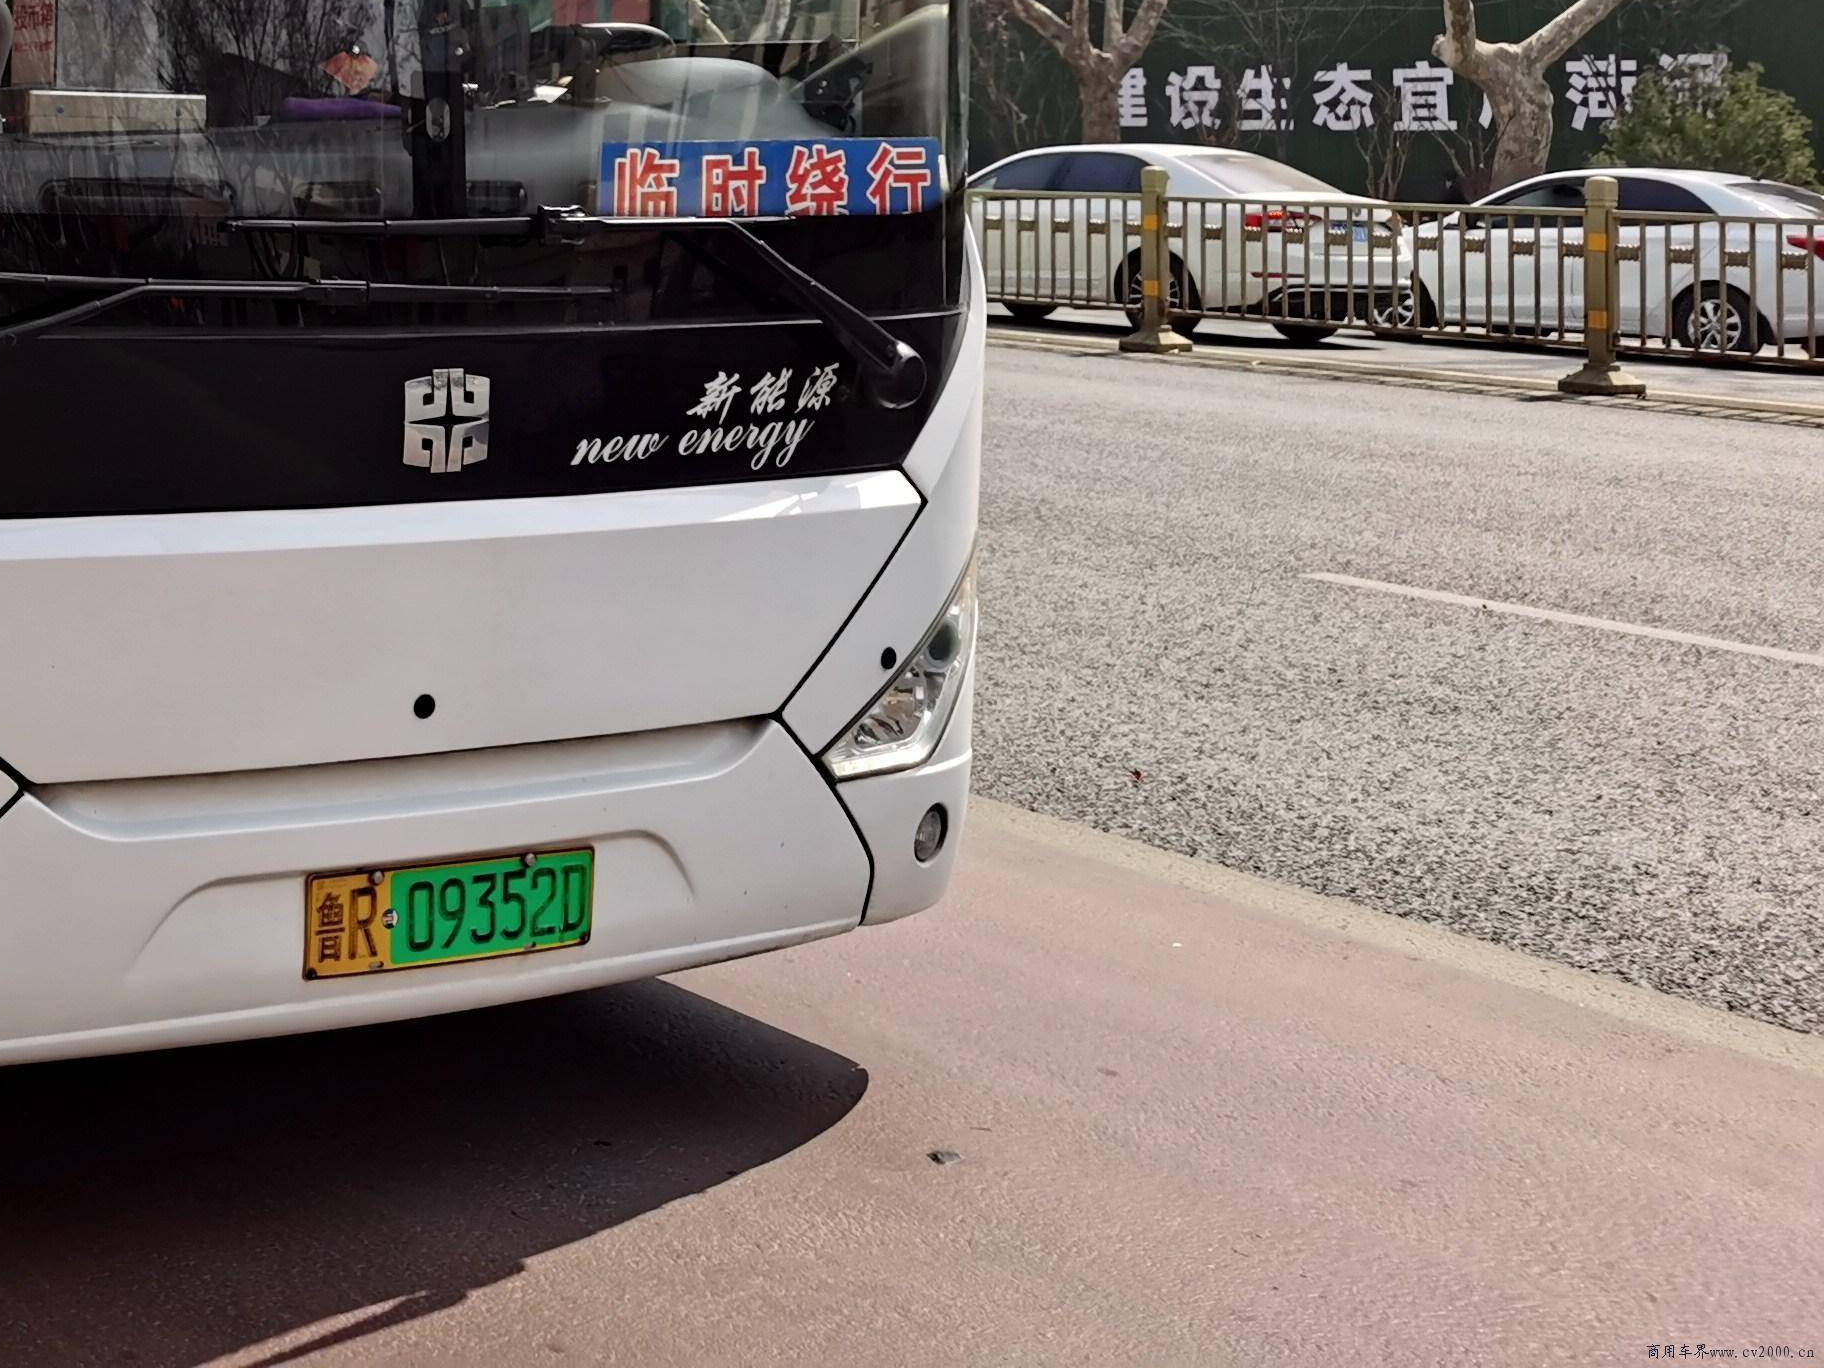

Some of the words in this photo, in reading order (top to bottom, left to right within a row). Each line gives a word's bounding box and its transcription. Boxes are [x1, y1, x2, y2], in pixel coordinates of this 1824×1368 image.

[1117, 53, 1729, 130] 建设生态宜菏
[614, 142, 931, 216] 临时绕行
[686, 362, 840, 427] 新能源
[571, 432, 669, 466] new
[678, 415, 817, 471] energy
